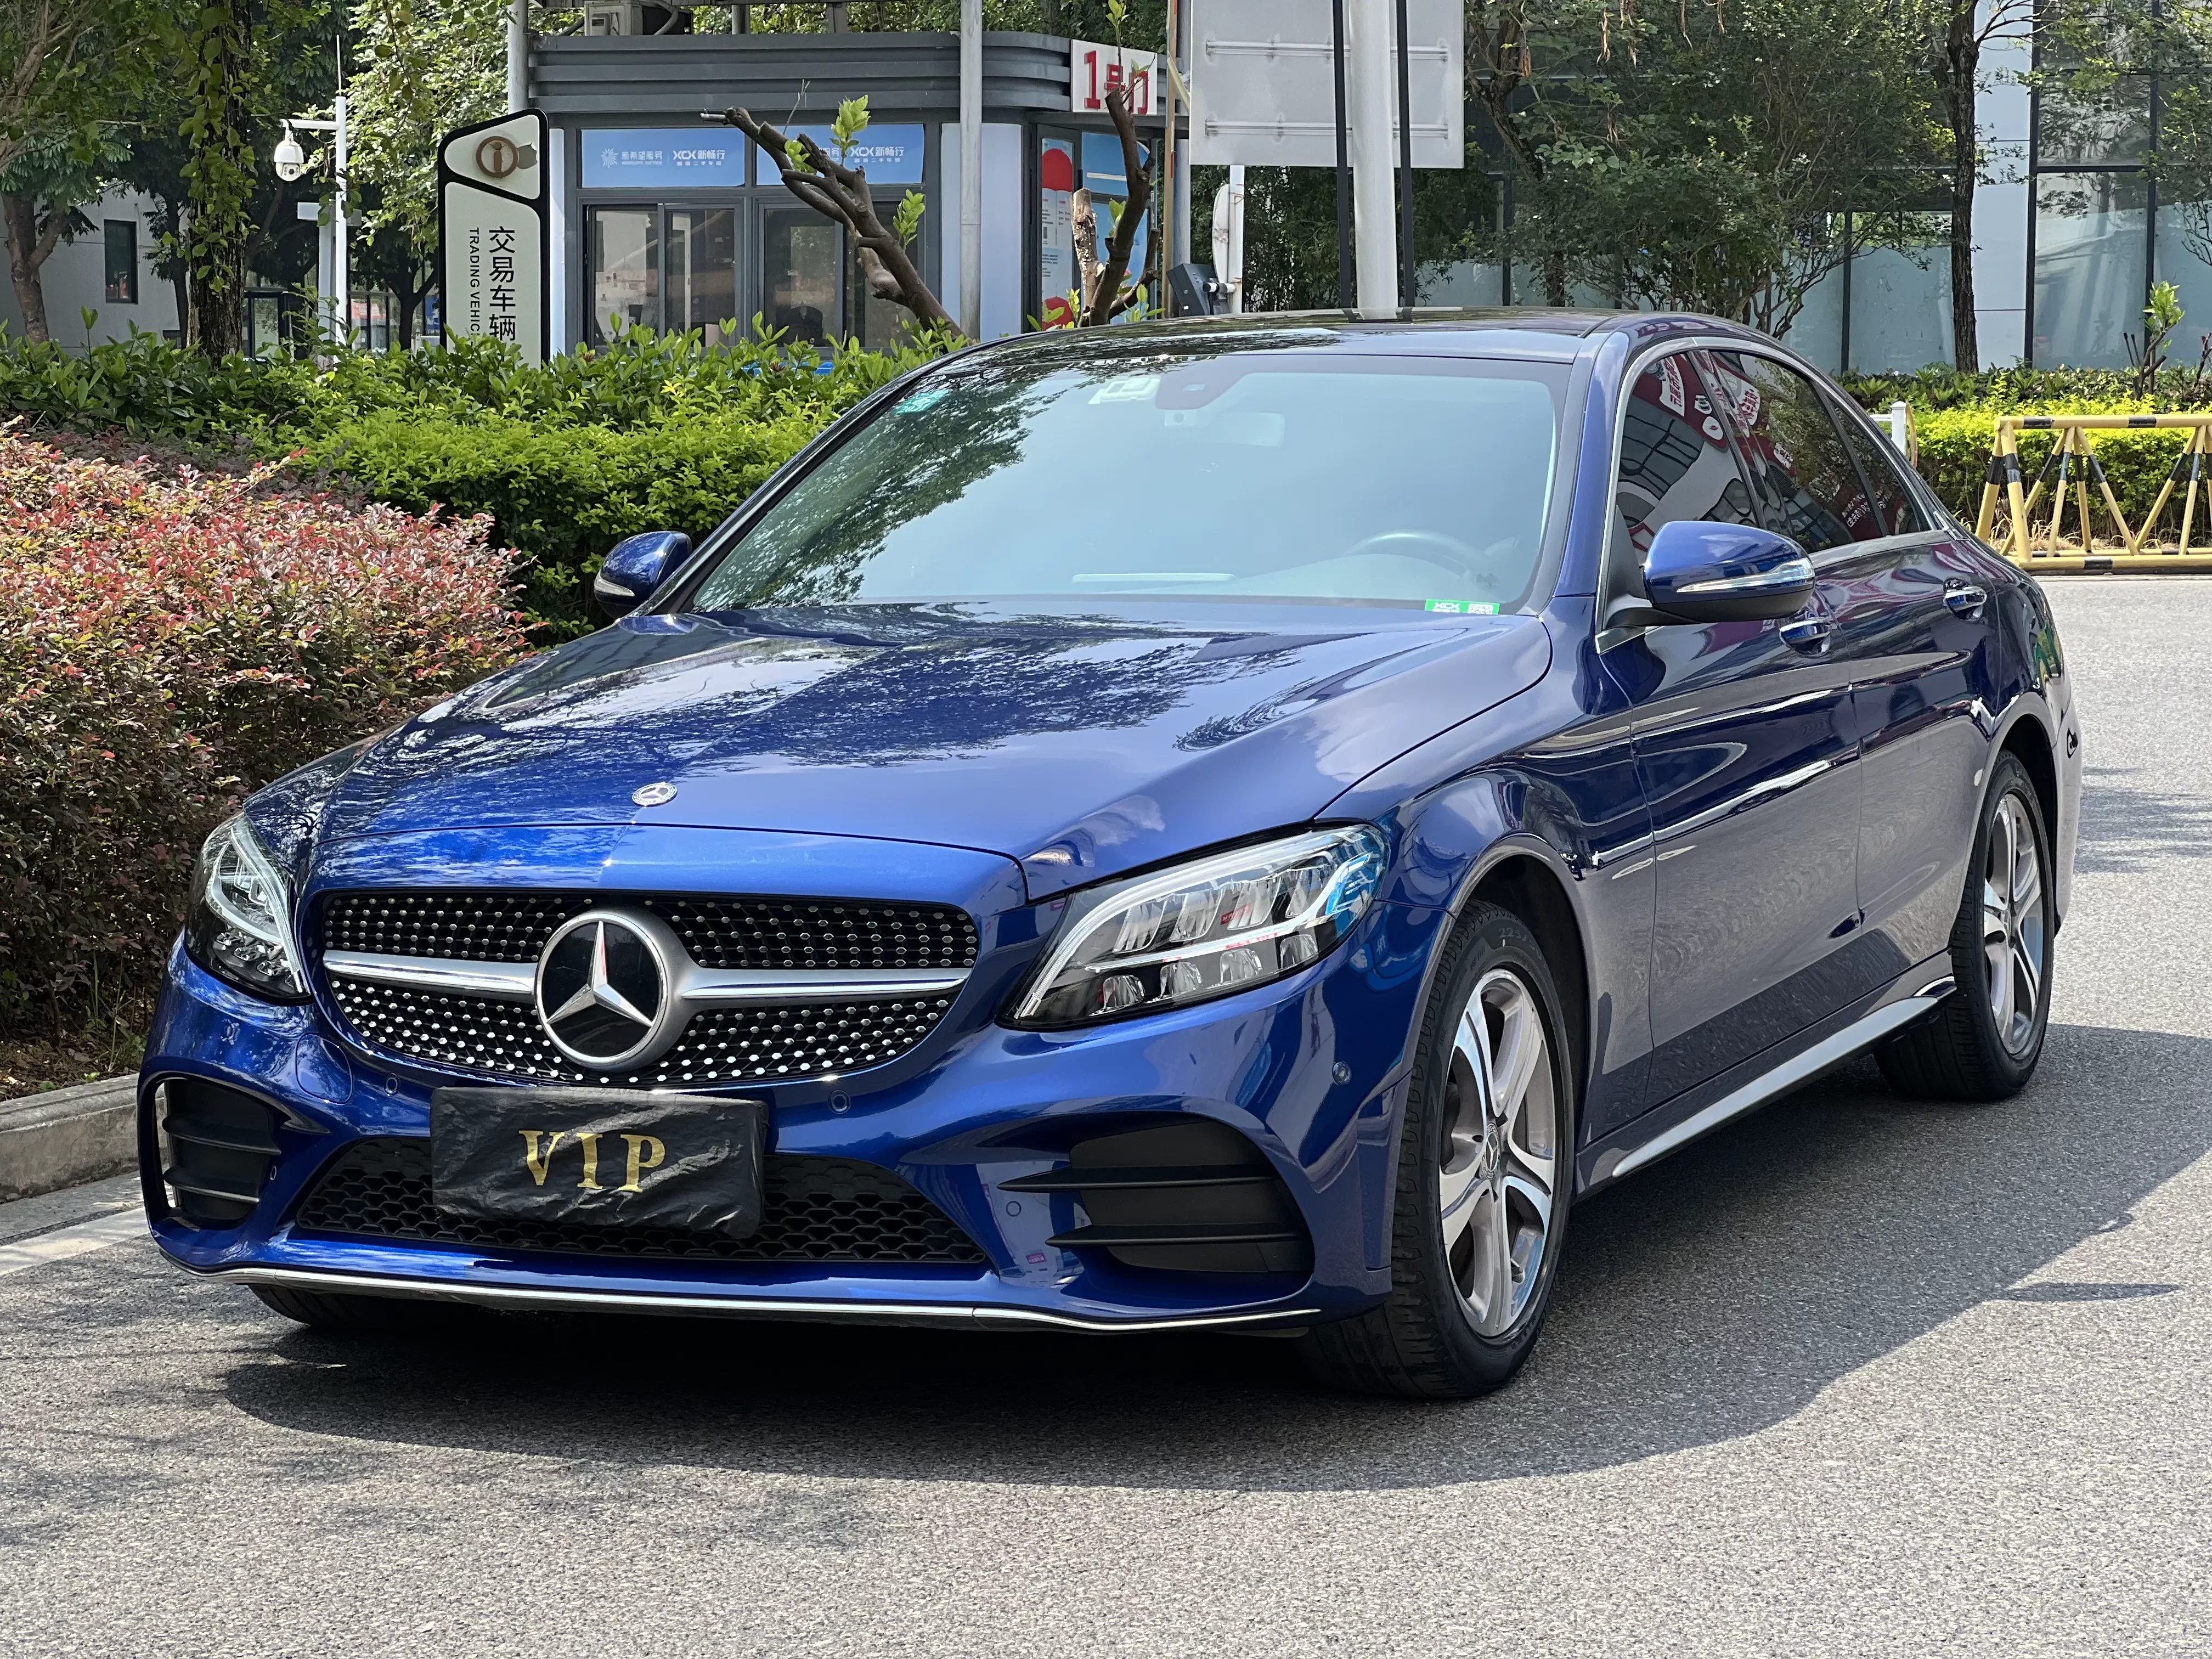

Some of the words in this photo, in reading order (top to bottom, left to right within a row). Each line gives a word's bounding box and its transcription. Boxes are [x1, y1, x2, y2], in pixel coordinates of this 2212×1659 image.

[470, 228, 480, 287] TRADING
[470, 291, 480, 345] VEHIC
[489, 226, 516, 362] 交易车辆
[518, 1130, 665, 1193] VIP
